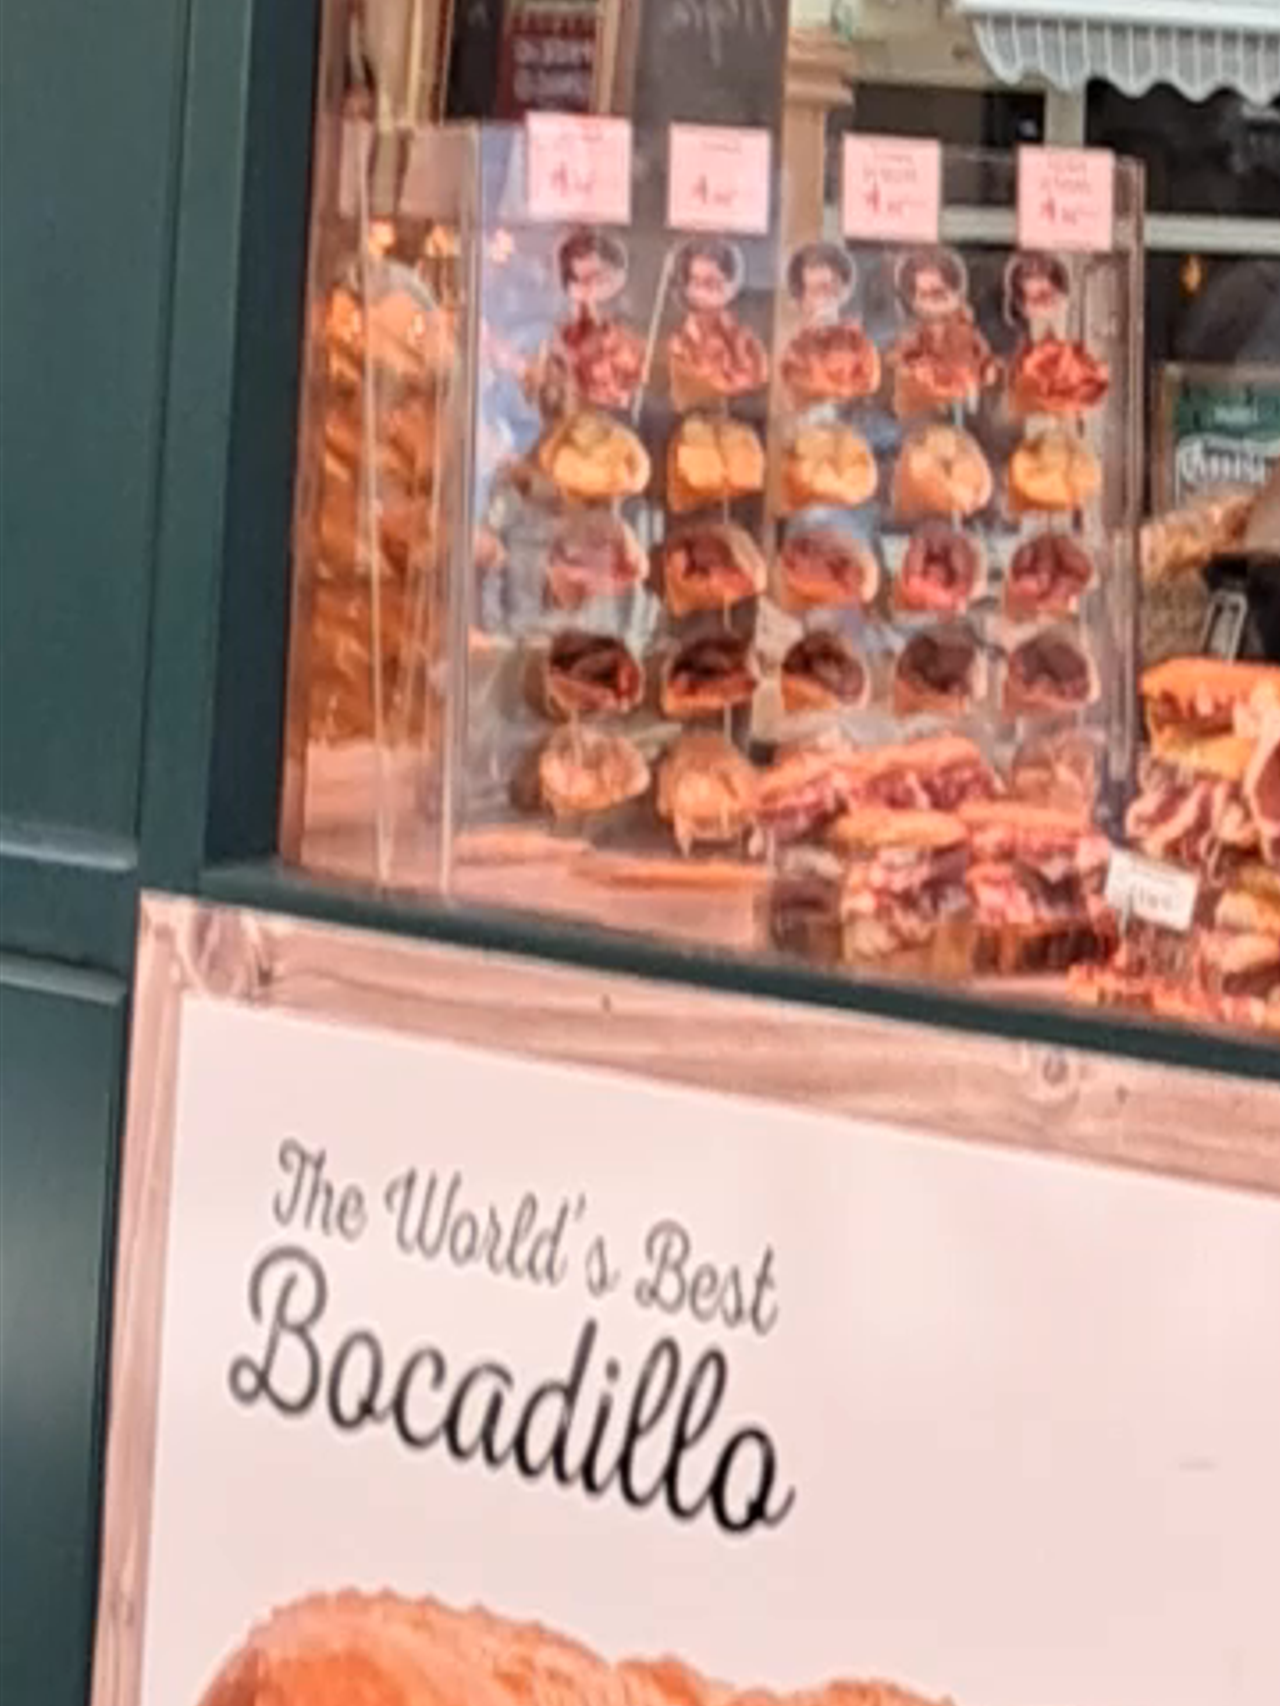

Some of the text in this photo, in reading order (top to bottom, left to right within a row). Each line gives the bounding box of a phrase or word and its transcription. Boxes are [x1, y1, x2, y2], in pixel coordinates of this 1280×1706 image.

[272, 1137, 779, 1336] The World's Best
[228, 1244, 796, 1534] Bocadillo
